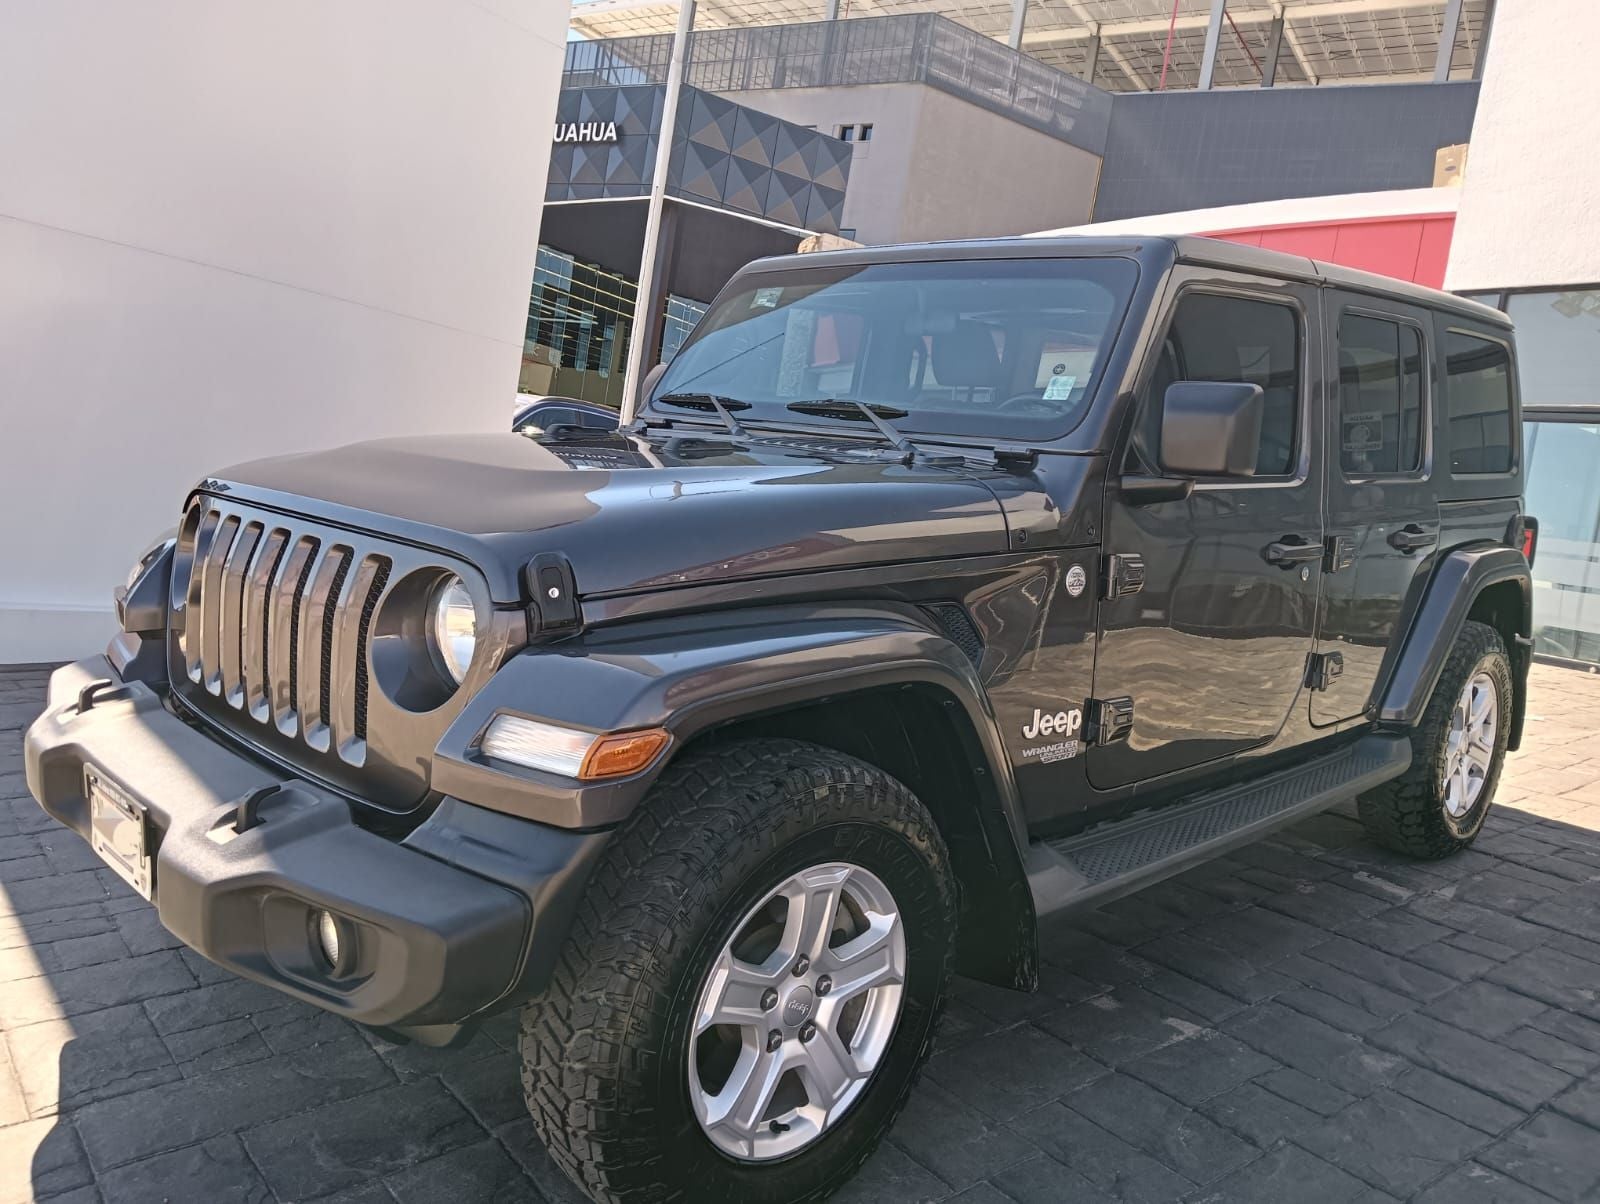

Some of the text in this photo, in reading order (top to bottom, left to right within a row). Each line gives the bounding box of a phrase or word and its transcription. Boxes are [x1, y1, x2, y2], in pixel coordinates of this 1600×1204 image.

[553, 121, 617, 142] UAHUA
[1022, 708, 1082, 739] Jeep
[1022, 739, 1078, 758] WRANGLER
